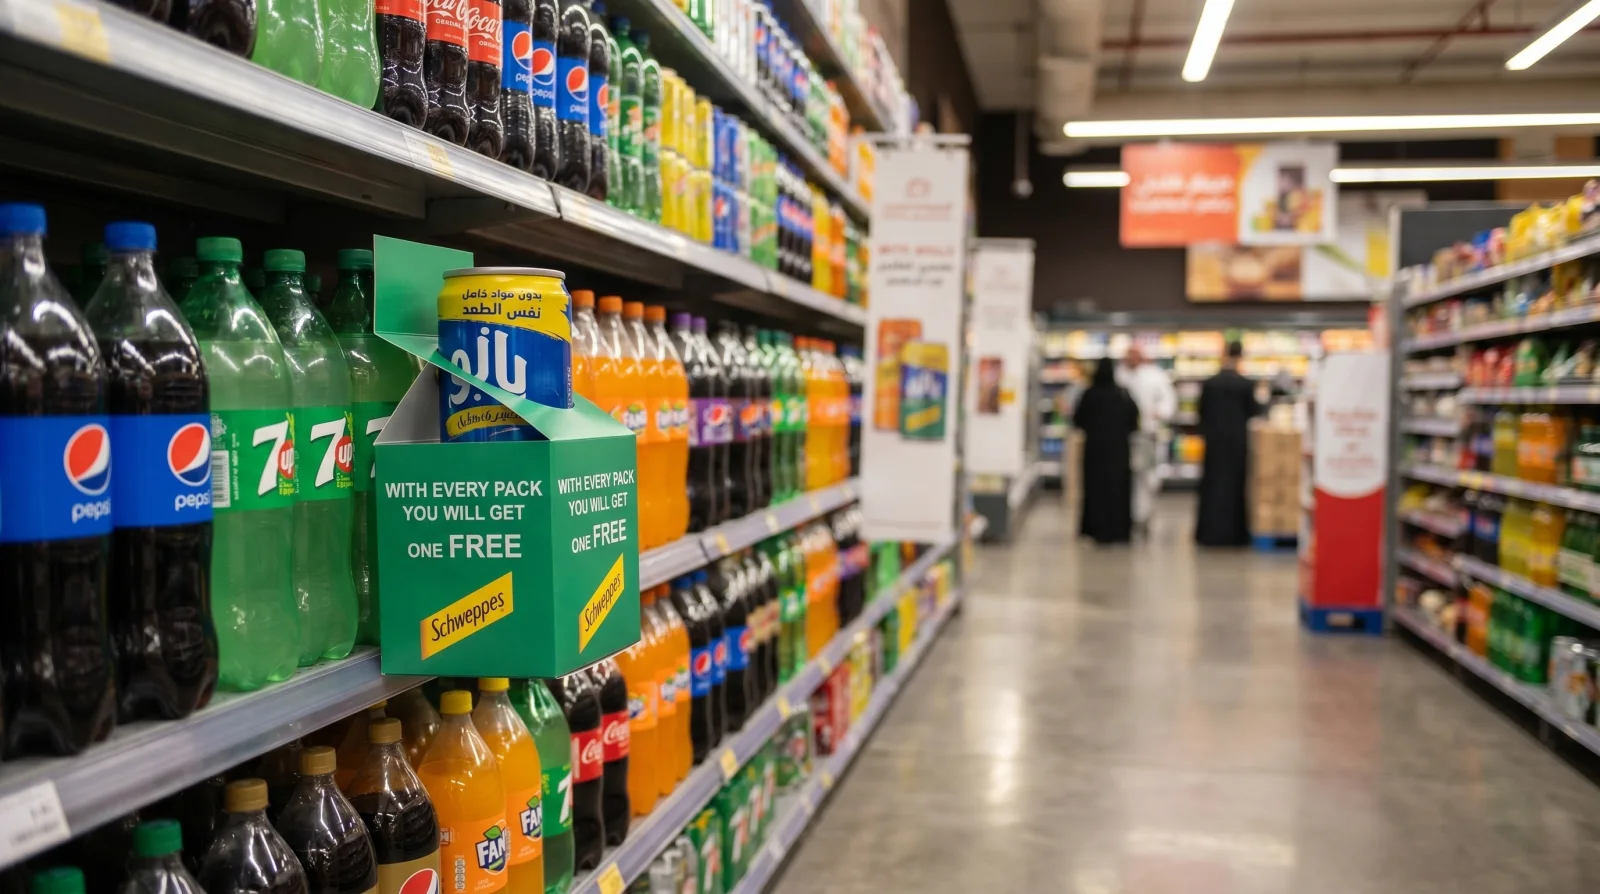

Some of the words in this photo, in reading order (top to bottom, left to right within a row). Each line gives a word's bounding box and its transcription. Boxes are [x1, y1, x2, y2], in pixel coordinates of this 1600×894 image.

[491, 290, 514, 300] مواد
[518, 290, 542, 302] بدون
[507, 307, 541, 320] نفس
[385, 483, 427, 498] WITH
[432, 482, 489, 498] EVERY
[494, 480, 543, 497] PACK
[558, 477, 582, 494] WITH
[584, 473, 612, 491] EVERY
[613, 469, 635, 487] PACK
[402, 505, 438, 521] YOU
[443, 505, 486, 521] WILL
[489, 504, 525, 521] GET
[568, 500, 588, 516] YOU
[590, 495, 610, 513] WILL
[611, 492, 628, 508] GET
[407, 543, 444, 558] ONE
[449, 534, 522, 558] FREE
[571, 535, 591, 554] ONE
[593, 518, 627, 548] FREE
[584, 573, 621, 632] Schweppes
[431, 592, 505, 642] Schweppes
